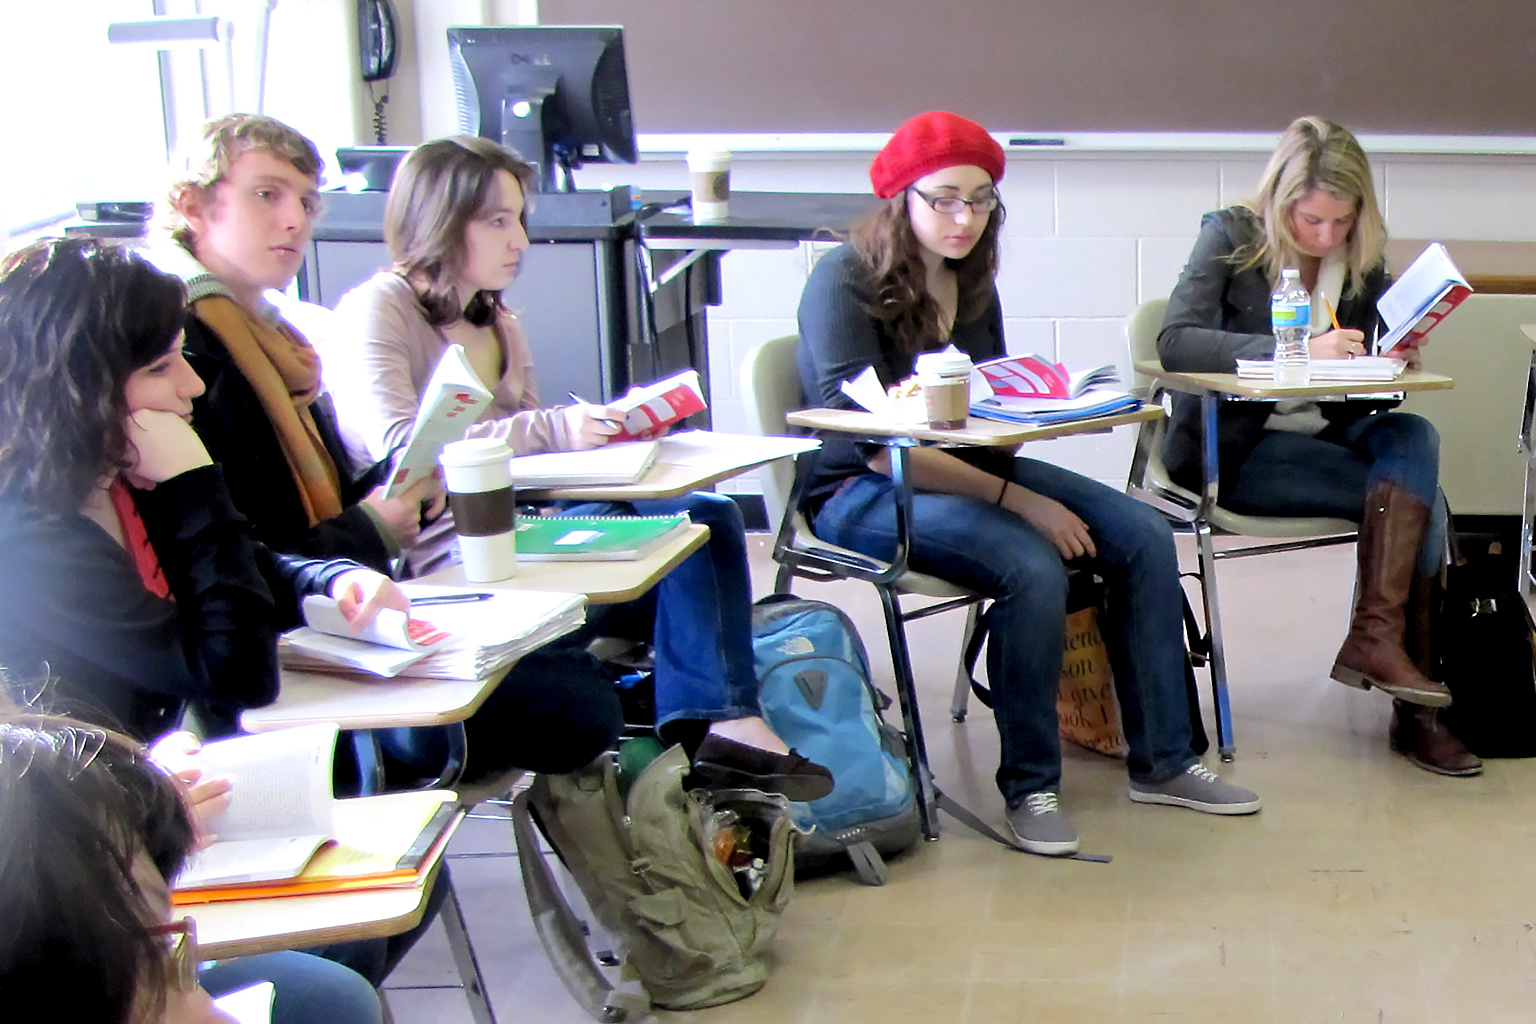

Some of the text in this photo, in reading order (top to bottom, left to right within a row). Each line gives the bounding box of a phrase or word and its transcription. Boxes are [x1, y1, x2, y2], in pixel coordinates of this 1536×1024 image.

[510, 53, 551, 66] DELL
[1071, 683, 1110, 711] give
[1060, 708, 1094, 729] ook
